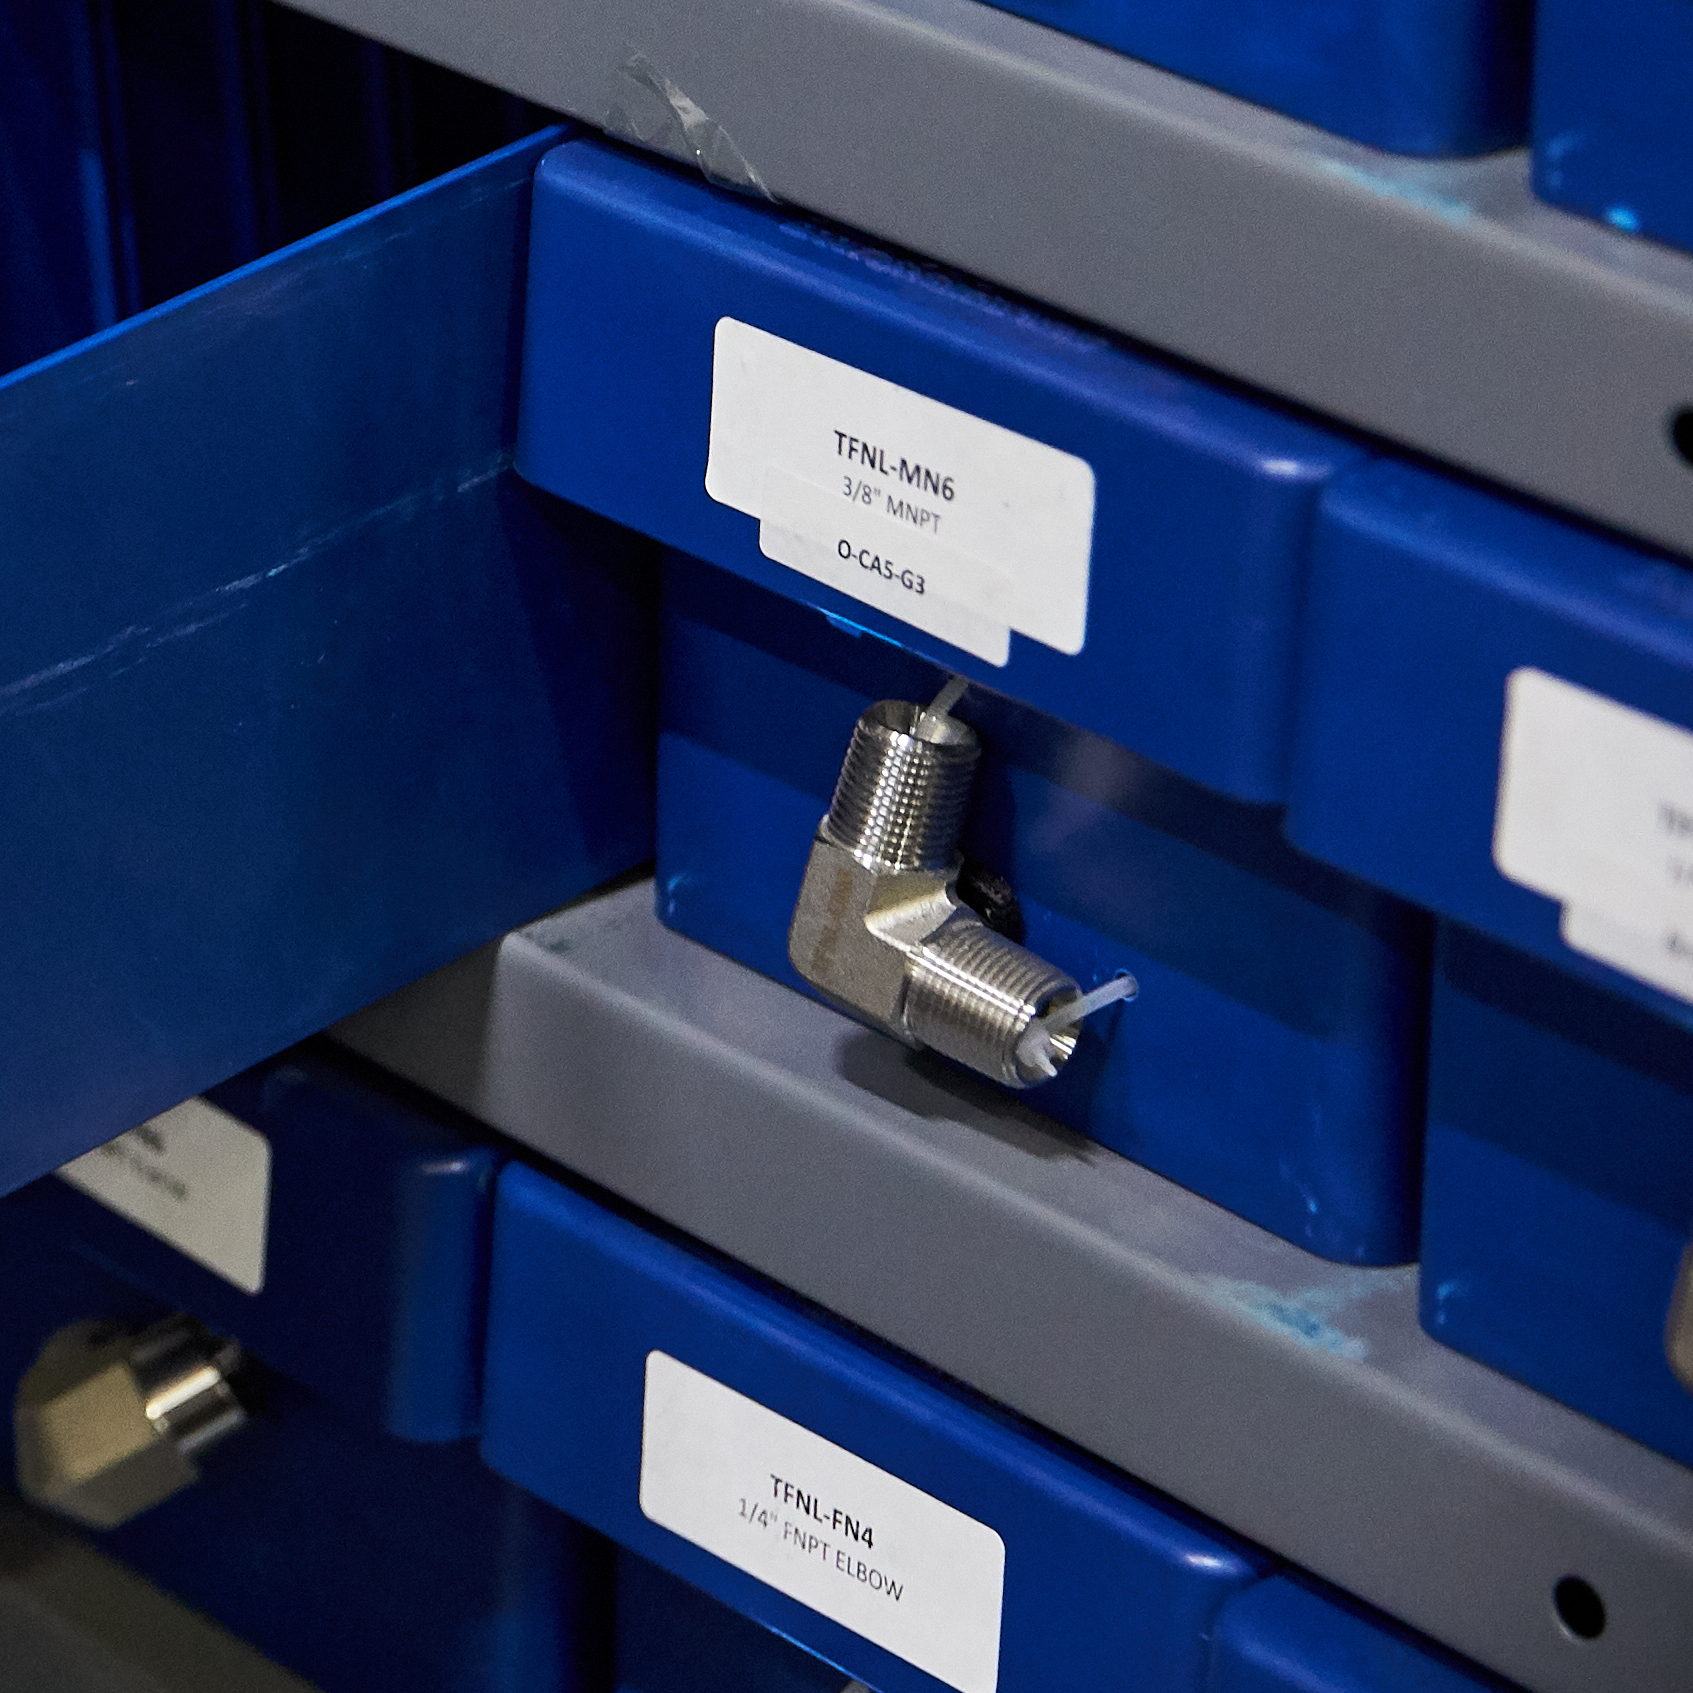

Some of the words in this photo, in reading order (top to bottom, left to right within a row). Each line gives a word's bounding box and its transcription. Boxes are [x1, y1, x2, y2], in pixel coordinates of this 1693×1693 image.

[834, 429, 955, 501] TFNL-MN6
[843, 475, 881, 505] 3/8"
[886, 495, 941, 535] MNPT
[838, 539, 925, 595] O-CA5-G3
[770, 1473, 874, 1549] TFNL-FN4
[738, 1497, 778, 1528] 1/4"
[783, 1521, 831, 1561] FNPT
[836, 1549, 904, 1602] ELBOW
